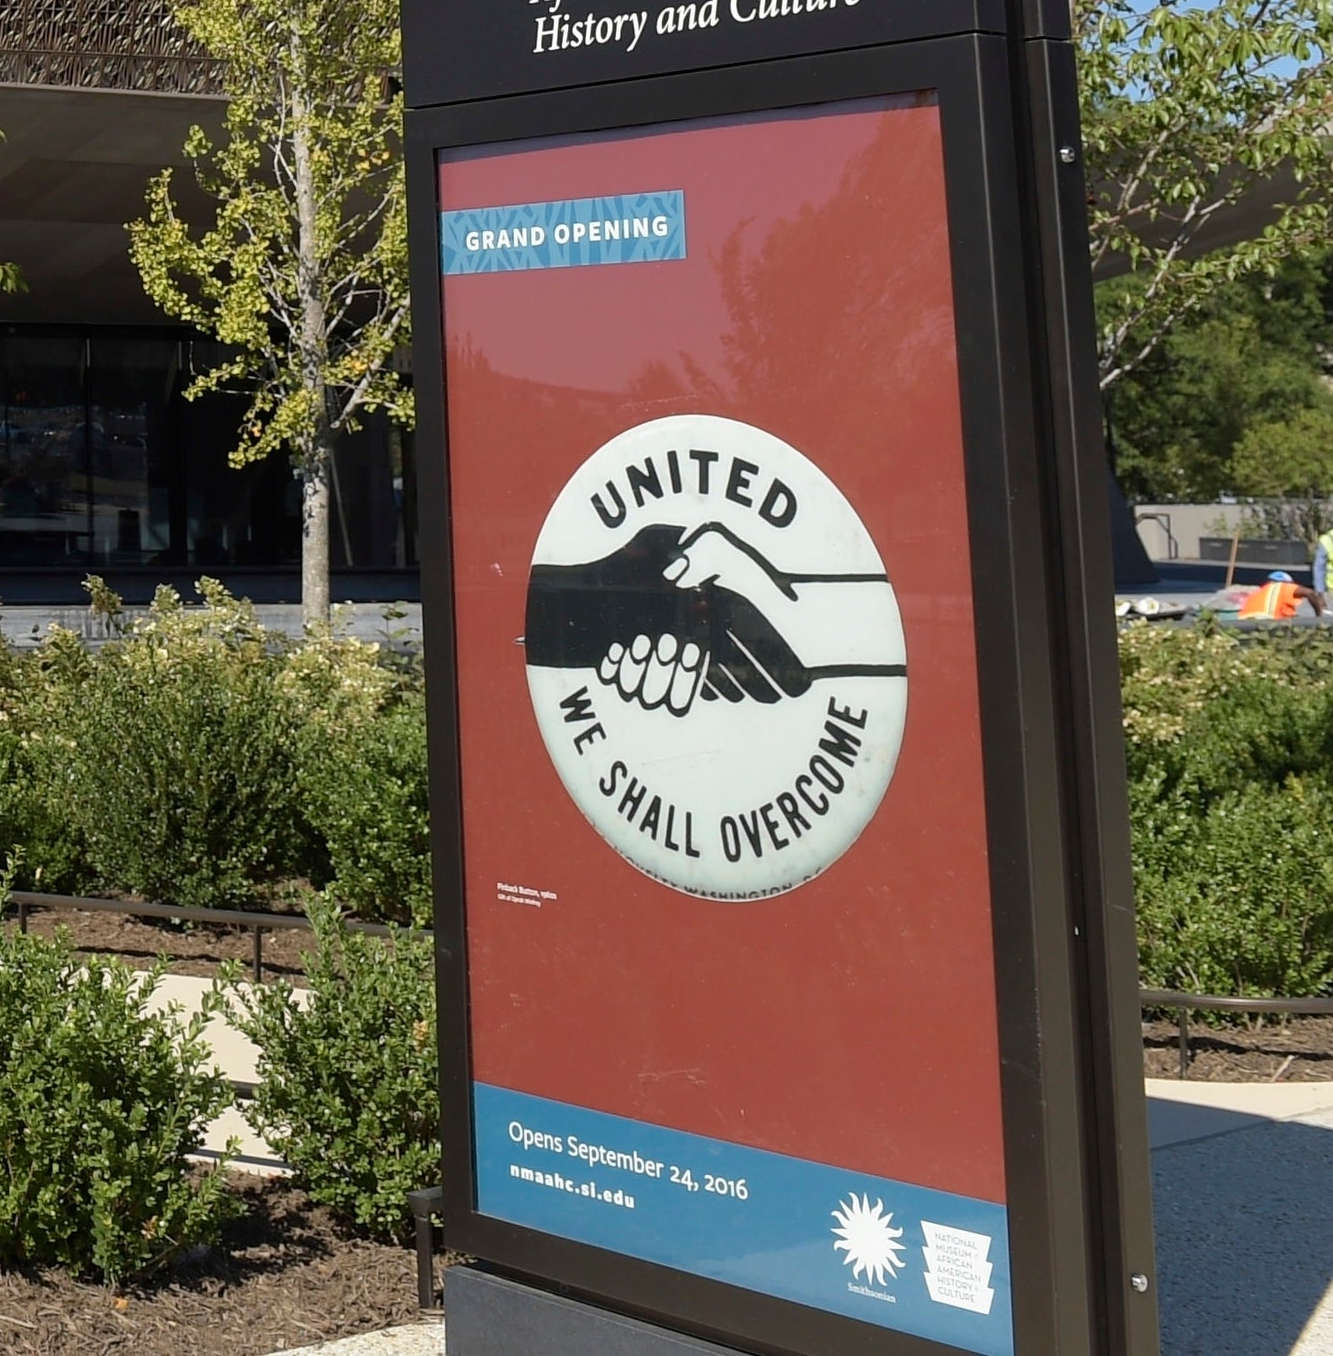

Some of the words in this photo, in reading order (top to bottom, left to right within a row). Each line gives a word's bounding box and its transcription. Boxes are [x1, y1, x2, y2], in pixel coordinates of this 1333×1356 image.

[533, 10, 647, 54] History
[465, 226, 545, 251] GRAND
[554, 215, 669, 245] OPENING
[590, 449, 797, 529] UNITED
[559, 686, 607, 756] WE
[599, 760, 701, 858] SHALL
[720, 696, 868, 863] OVERCOME
[508, 1121, 563, 1153] Opens
[568, 1136, 664, 1178] September
[669, 1165, 699, 1192] 24,
[704, 1174, 749, 1200] 2016
[510, 1164, 635, 1209] nmaahc.si.edu
[935, 1232, 977, 1250] NATIONAL
[935, 1244, 972, 1258] MUSEUM
[936, 1255, 972, 1269] AFRICAN
[937, 1265, 981, 1282] AMERICAN
[937, 1275, 972, 1291] HISTORY
[847, 1282, 896, 1304] Smithsonian
[938, 1286, 974, 1303] CULTURE
